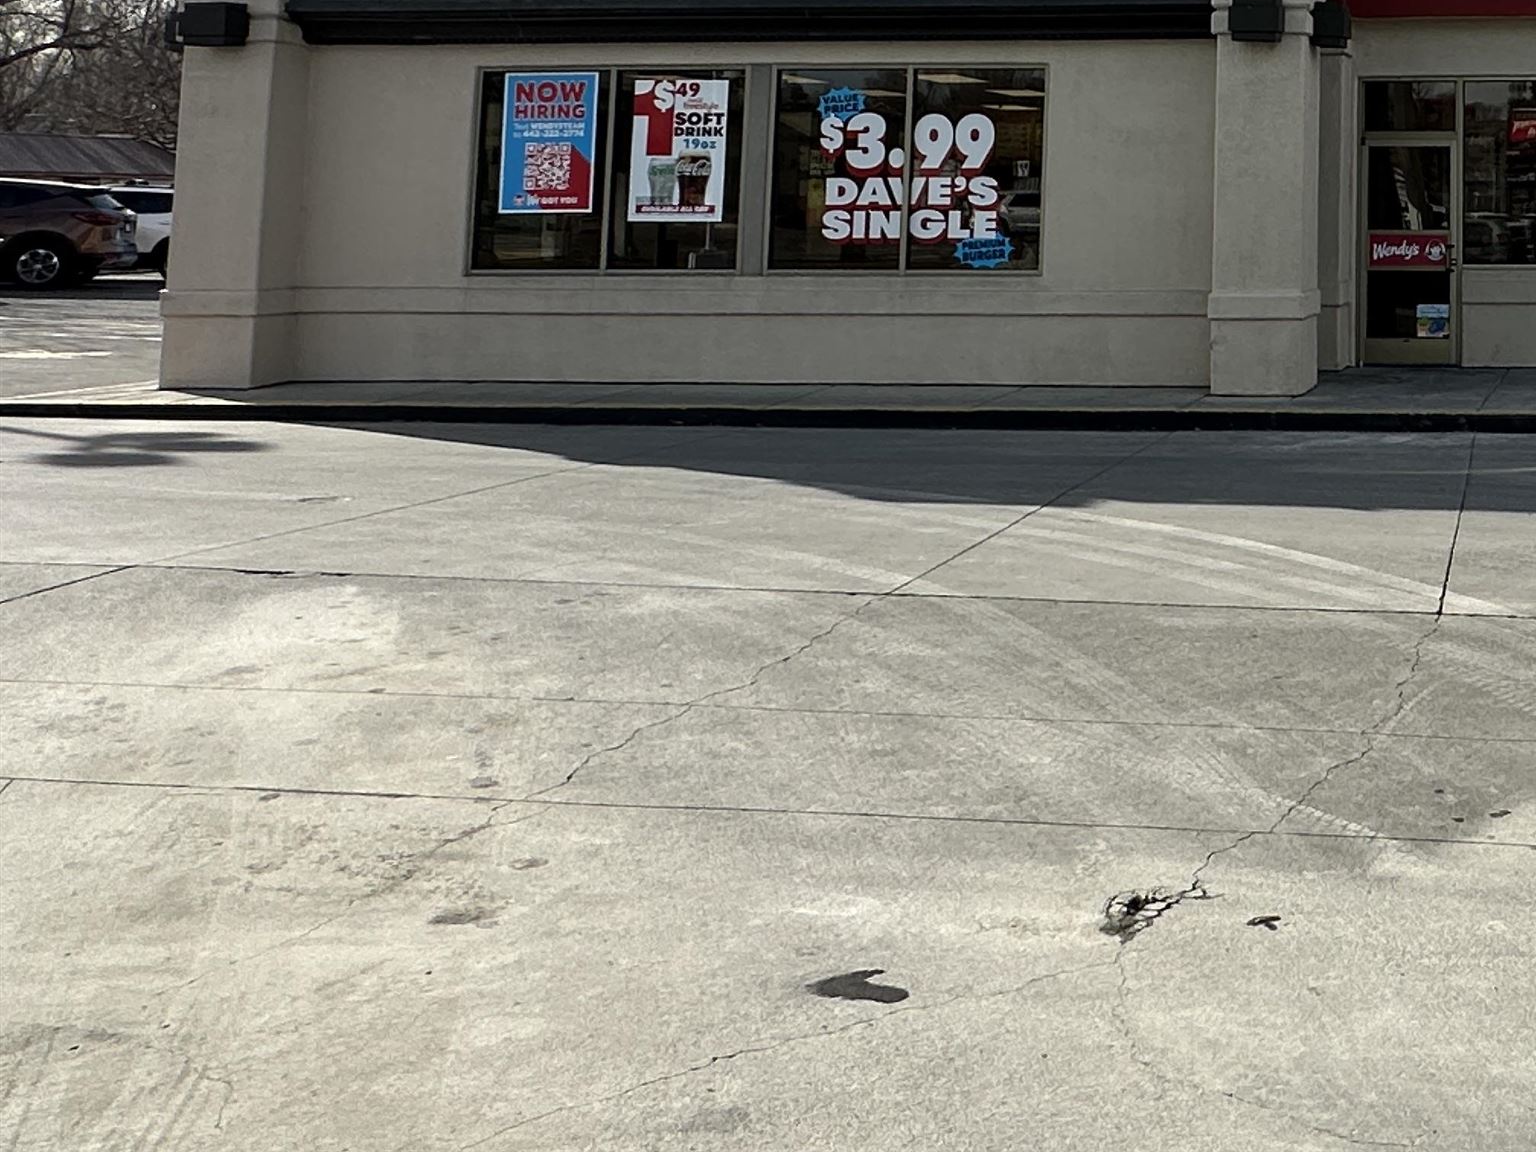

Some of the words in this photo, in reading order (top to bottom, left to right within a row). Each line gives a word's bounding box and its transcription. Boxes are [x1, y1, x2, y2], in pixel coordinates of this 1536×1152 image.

[515, 81, 587, 103] NOW
[822, 94, 859, 104] VALUE
[514, 104, 586, 120] HIRING
[823, 103, 859, 114] PRICE
[675, 112, 725, 126] SOFT
[674, 127, 724, 137] DRINK
[819, 111, 996, 170] $3.99
[824, 175, 999, 206] DAVE'S
[821, 209, 998, 240] SINGLE
[962, 248, 1006, 262] BURGER
[1372, 241, 1420, 261] Wendy's
